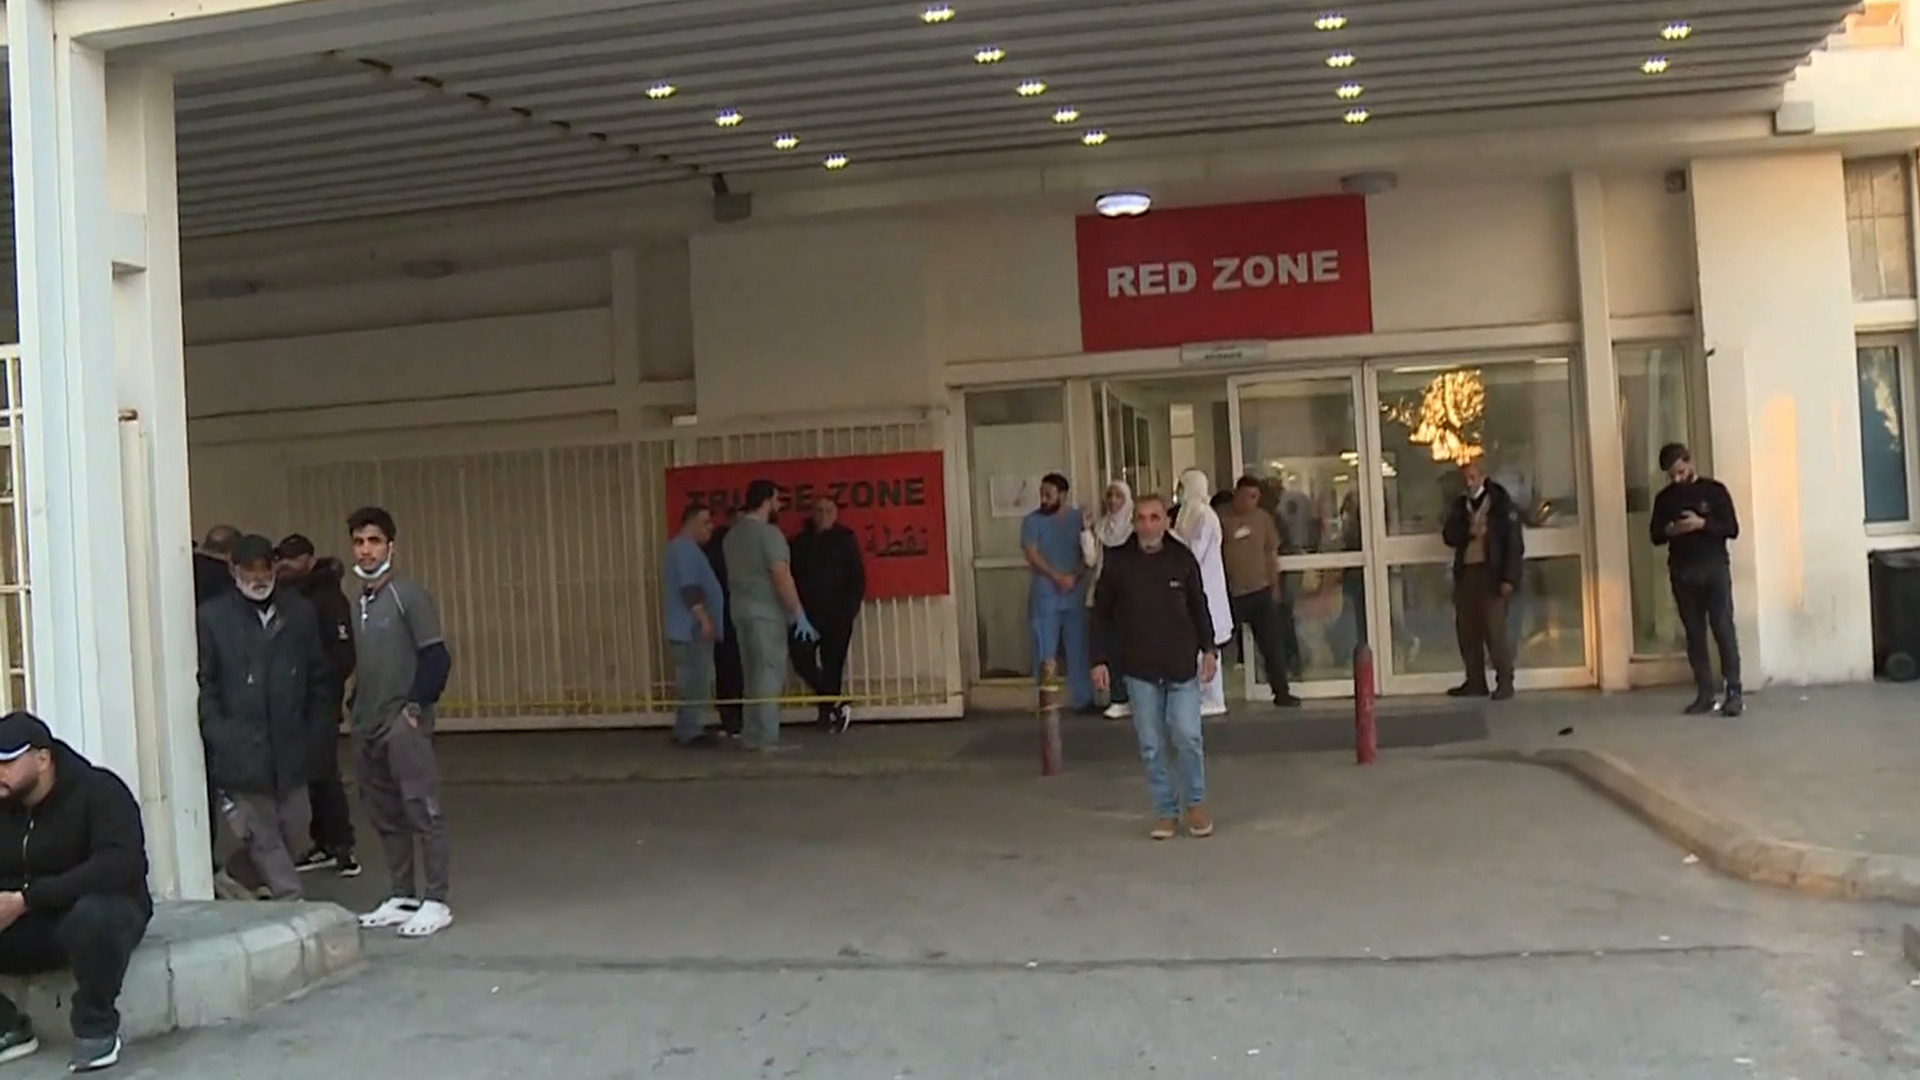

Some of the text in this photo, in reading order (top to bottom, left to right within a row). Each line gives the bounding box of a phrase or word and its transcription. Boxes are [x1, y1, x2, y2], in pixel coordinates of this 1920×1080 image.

[1107, 249, 1340, 298] RED ZONE
[828, 477, 925, 509] ZONE
